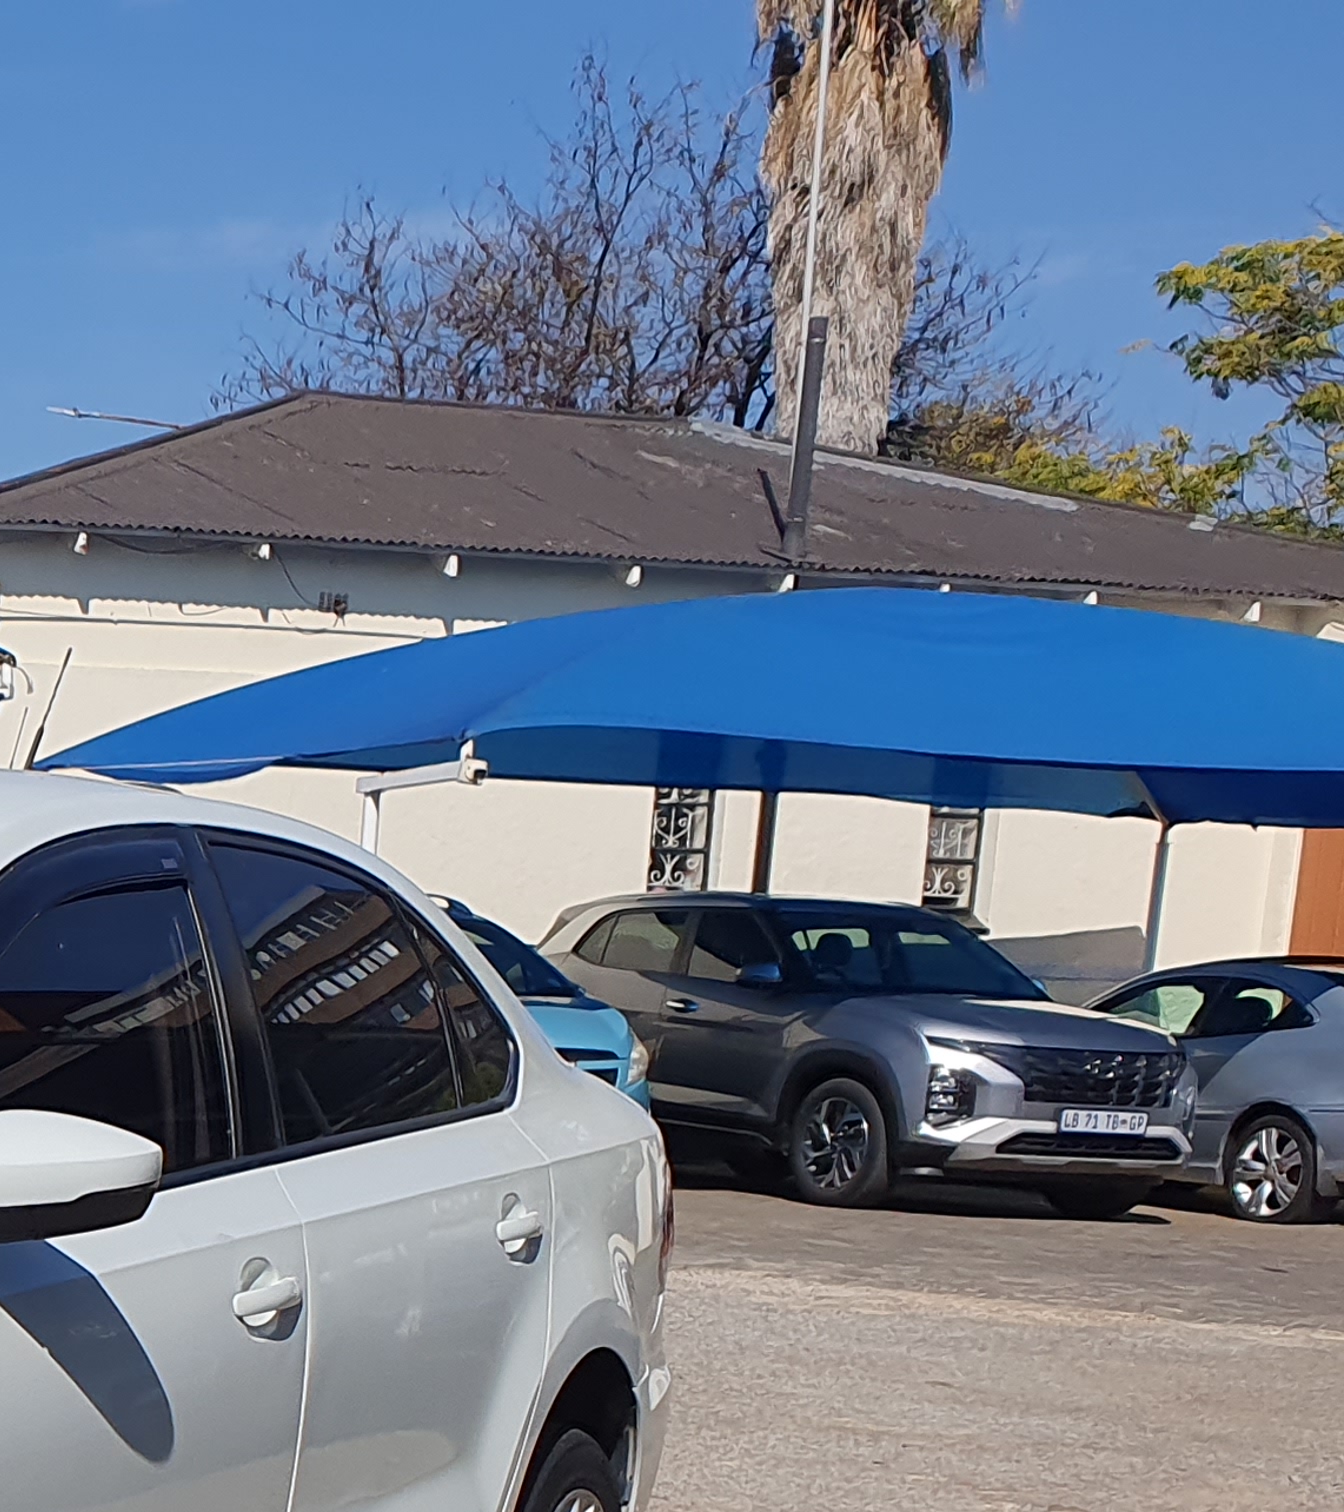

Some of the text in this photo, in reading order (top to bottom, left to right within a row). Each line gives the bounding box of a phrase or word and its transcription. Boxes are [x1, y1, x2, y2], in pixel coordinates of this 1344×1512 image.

[1063, 1112, 1145, 1131] LB 71 TB GP
